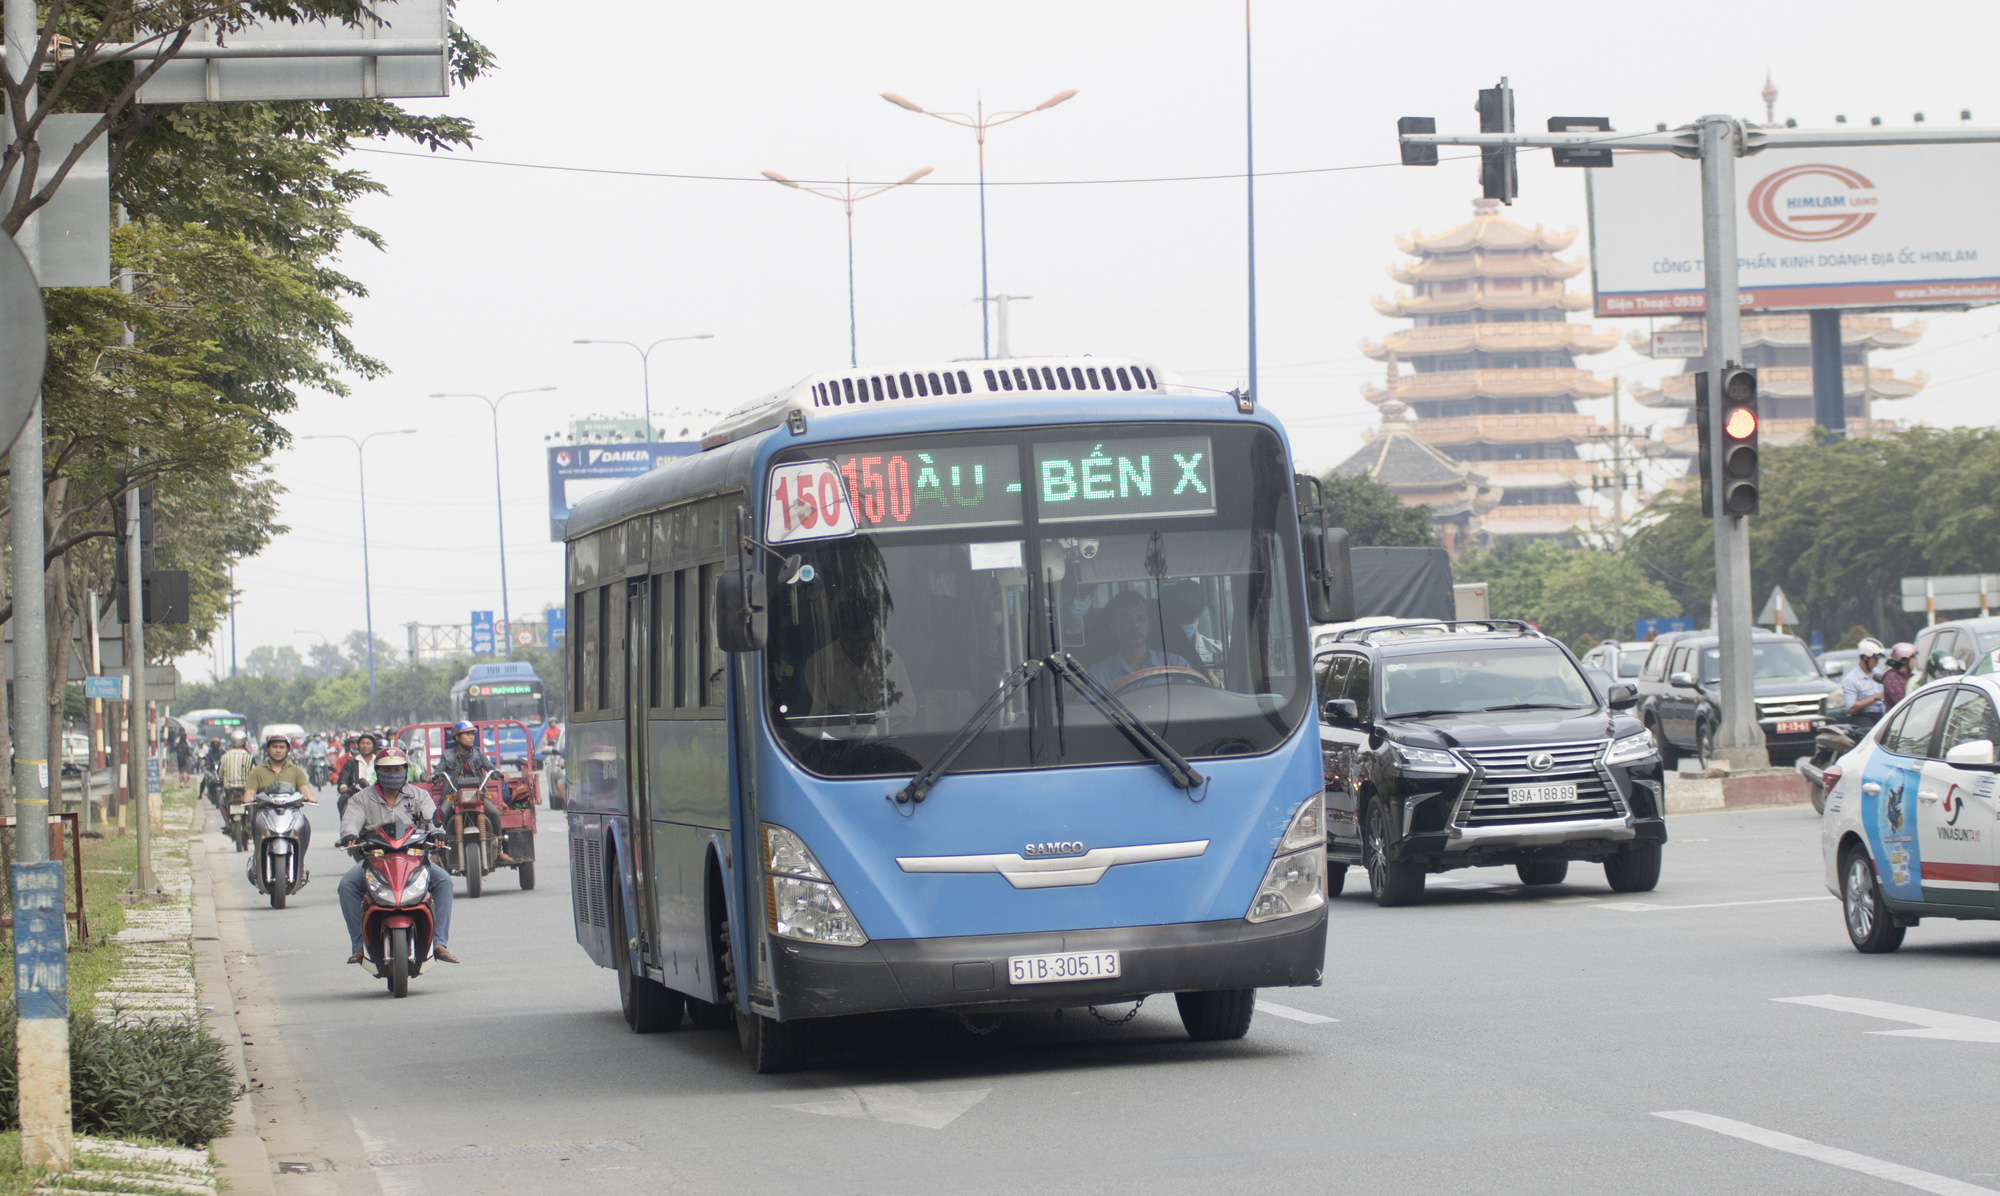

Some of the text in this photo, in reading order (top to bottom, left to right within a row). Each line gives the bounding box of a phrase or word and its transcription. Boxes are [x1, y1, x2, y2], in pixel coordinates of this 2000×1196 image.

[1787, 196, 1846, 209] HIMLAM
[1653, 257, 1692, 274] CÔNG
[1780, 256, 1815, 268] KINH
[1818, 253, 1868, 267] DOANH
[1921, 249, 1978, 263] HIMLAM
[1673, 295, 1704, 308] 0939
[601, 449, 650, 463] DAIKIN
[841, 455, 911, 524] 150
[1042, 444, 1152, 502] BẾN
[1173, 453, 1207, 495] X
[775, 471, 841, 531] 150
[1510, 786, 1575, 802] 89A-188.89
[1024, 841, 1084, 857] SAMCO
[1013, 954, 1116, 981] 51B-305.13
